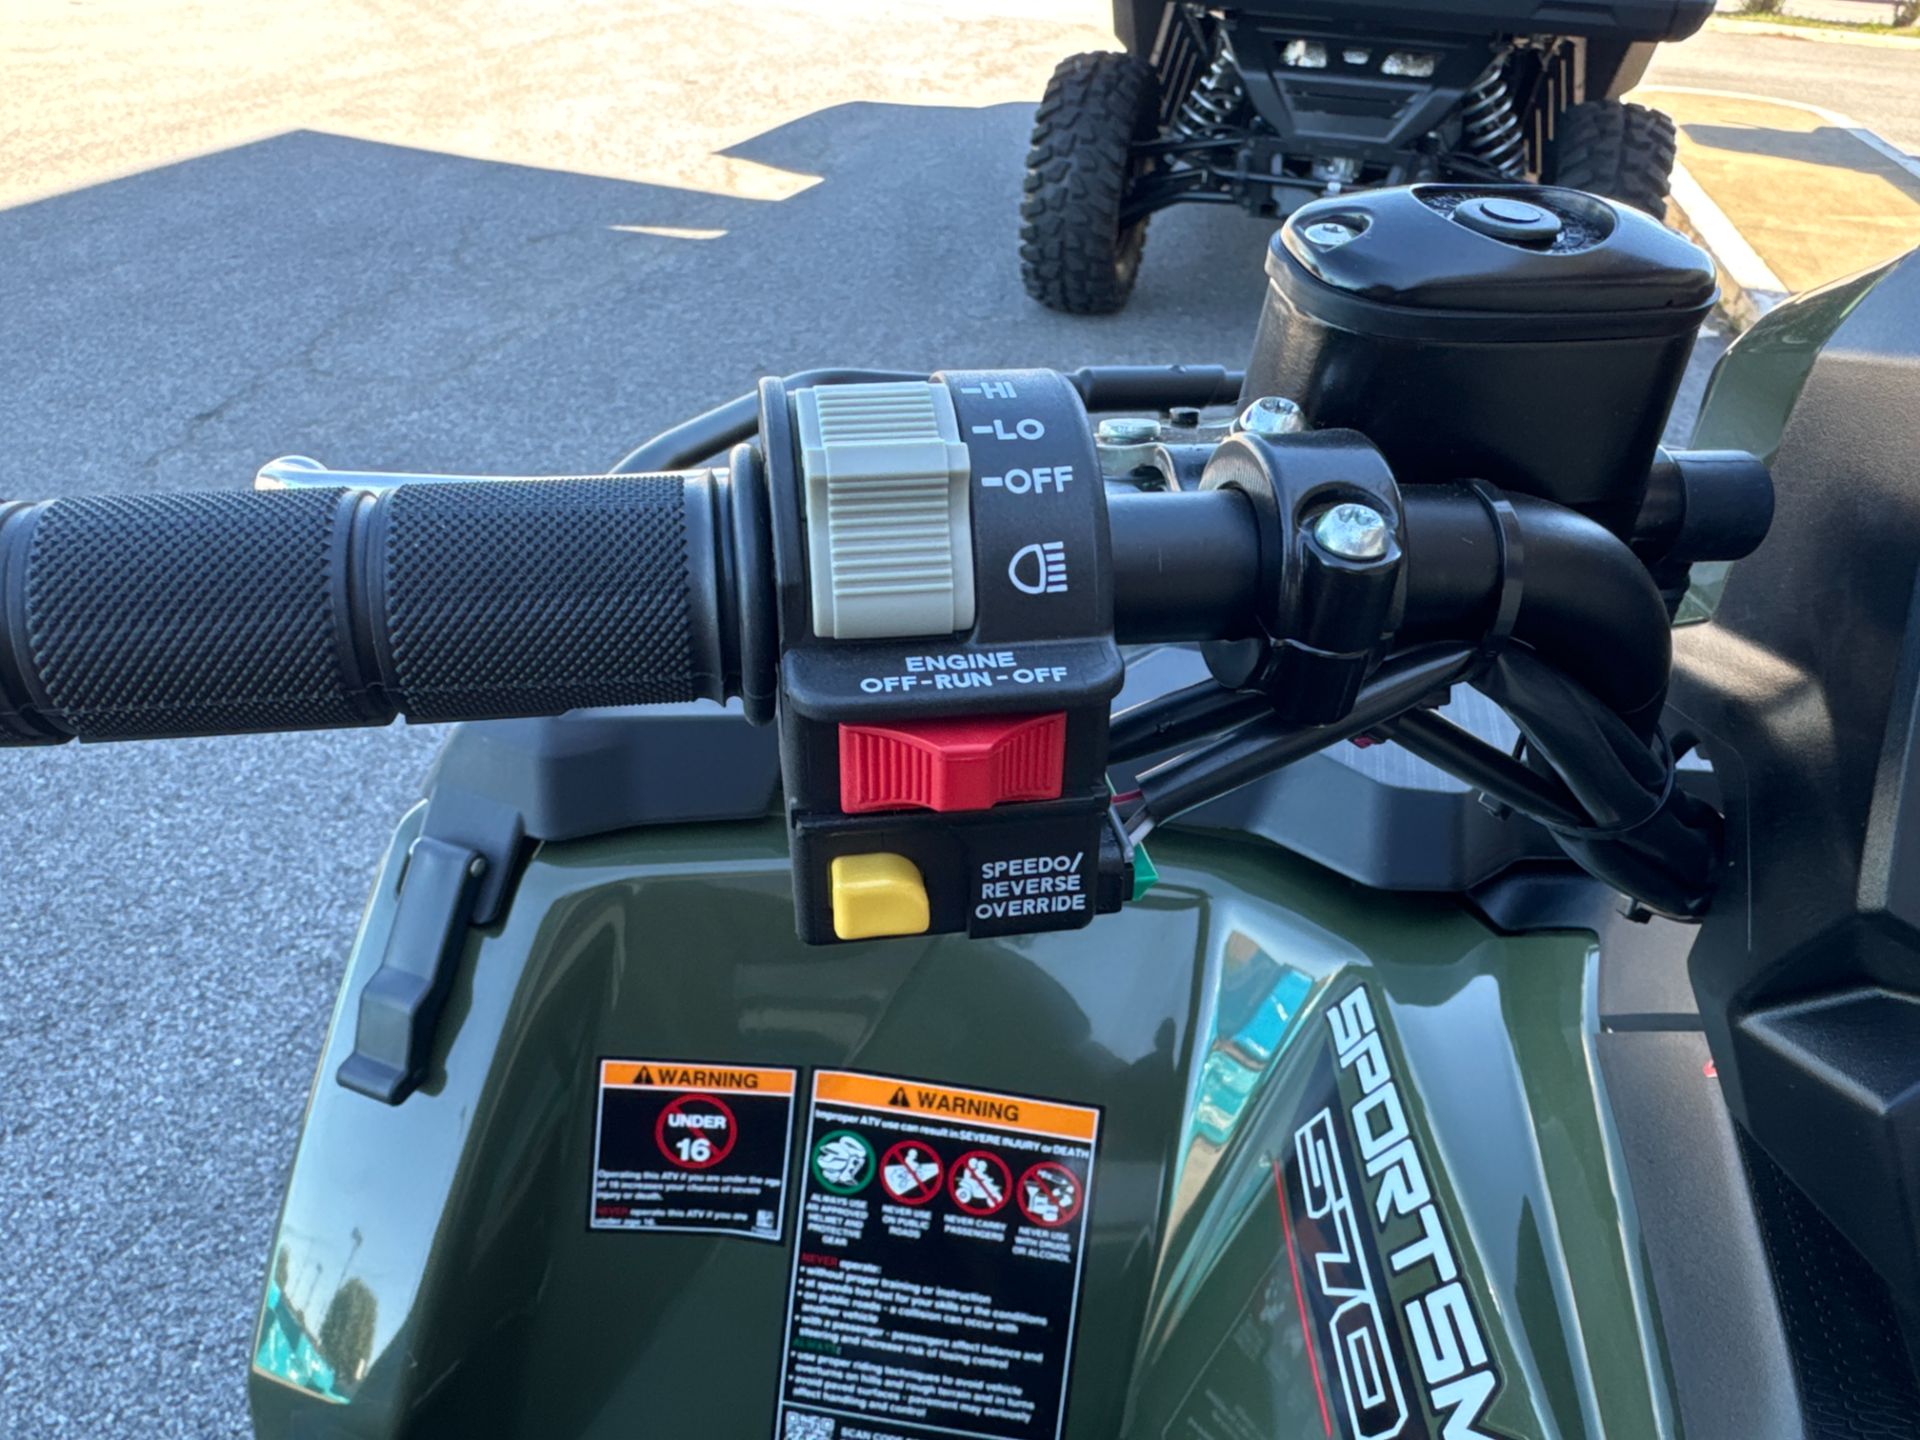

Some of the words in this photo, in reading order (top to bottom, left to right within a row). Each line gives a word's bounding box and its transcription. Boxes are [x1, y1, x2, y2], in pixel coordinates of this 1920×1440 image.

[905, 651, 1016, 672] ENGINE
[981, 851, 1084, 879] SPEEDO/
[982, 874, 1081, 899] REVERSE
[975, 894, 1086, 919] OVERRIDE
[658, 1069, 758, 1089] WARNING
[917, 1090, 1019, 1122] WARNING
[668, 1113, 727, 1130] UNDER
[815, 1109, 858, 1125] Improper
[859, 1115, 881, 1128] ATV
[881, 1119, 899, 1130] use
[901, 1122, 919, 1133] can
[920, 1124, 948, 1137] result
[948, 1128, 959, 1139] in
[960, 1130, 999, 1145] SEVERE
[1001, 1136, 1041, 1151] INJURY
[1041, 1144, 1052, 1153] or
[1052, 1143, 1089, 1160] DEATH
[676, 1138, 711, 1162] 16
[1294, 1107, 1408, 1440] 570
